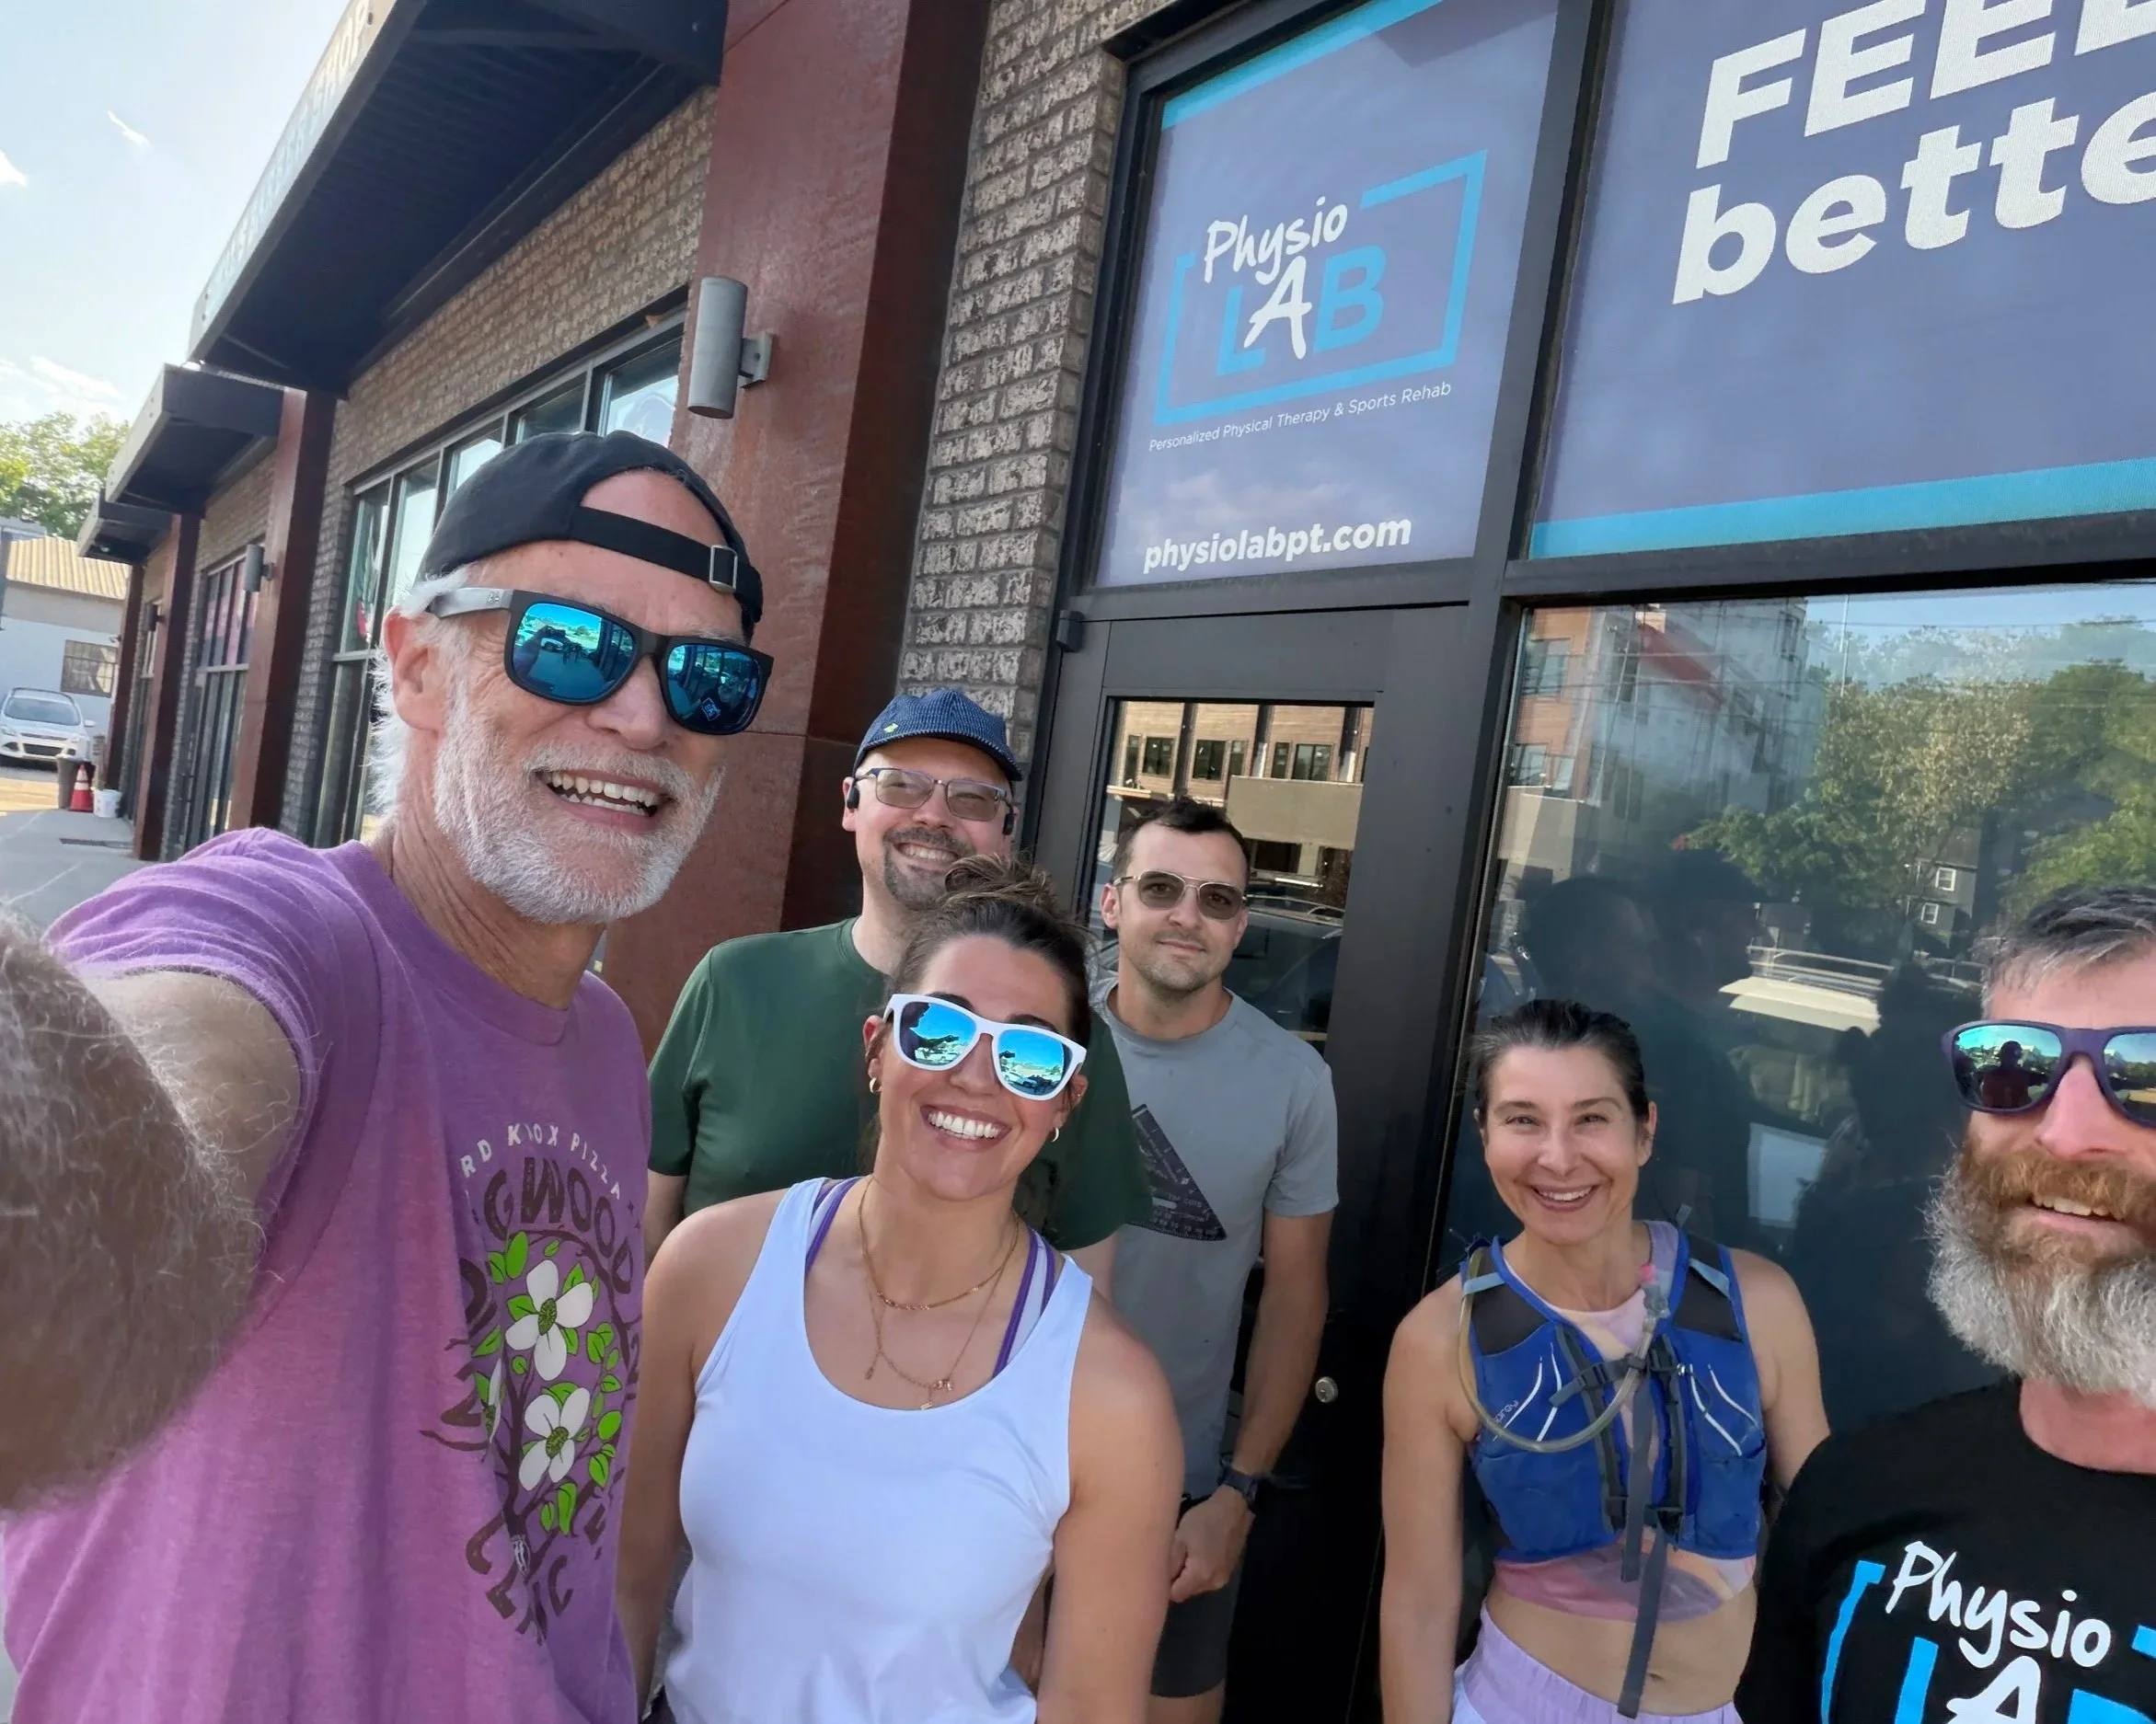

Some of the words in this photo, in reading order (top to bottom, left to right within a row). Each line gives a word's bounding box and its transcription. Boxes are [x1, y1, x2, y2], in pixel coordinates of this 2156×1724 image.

[1204, 195, 1348, 284] Physio
[1216, 244, 1388, 376] LAB
[1148, 426, 1220, 452] Personalized
[1223, 416, 1274, 438] Physical
[1277, 407, 1331, 427] Therapy
[1333, 402, 1344, 417] &
[1348, 393, 1397, 415] Sports
[1401, 381, 1451, 404] Rehab
[1142, 514, 1412, 574] physiolabpt.com
[570, 1132, 620, 1201] PIZZA
[1885, 1540, 2111, 1669] Physio
